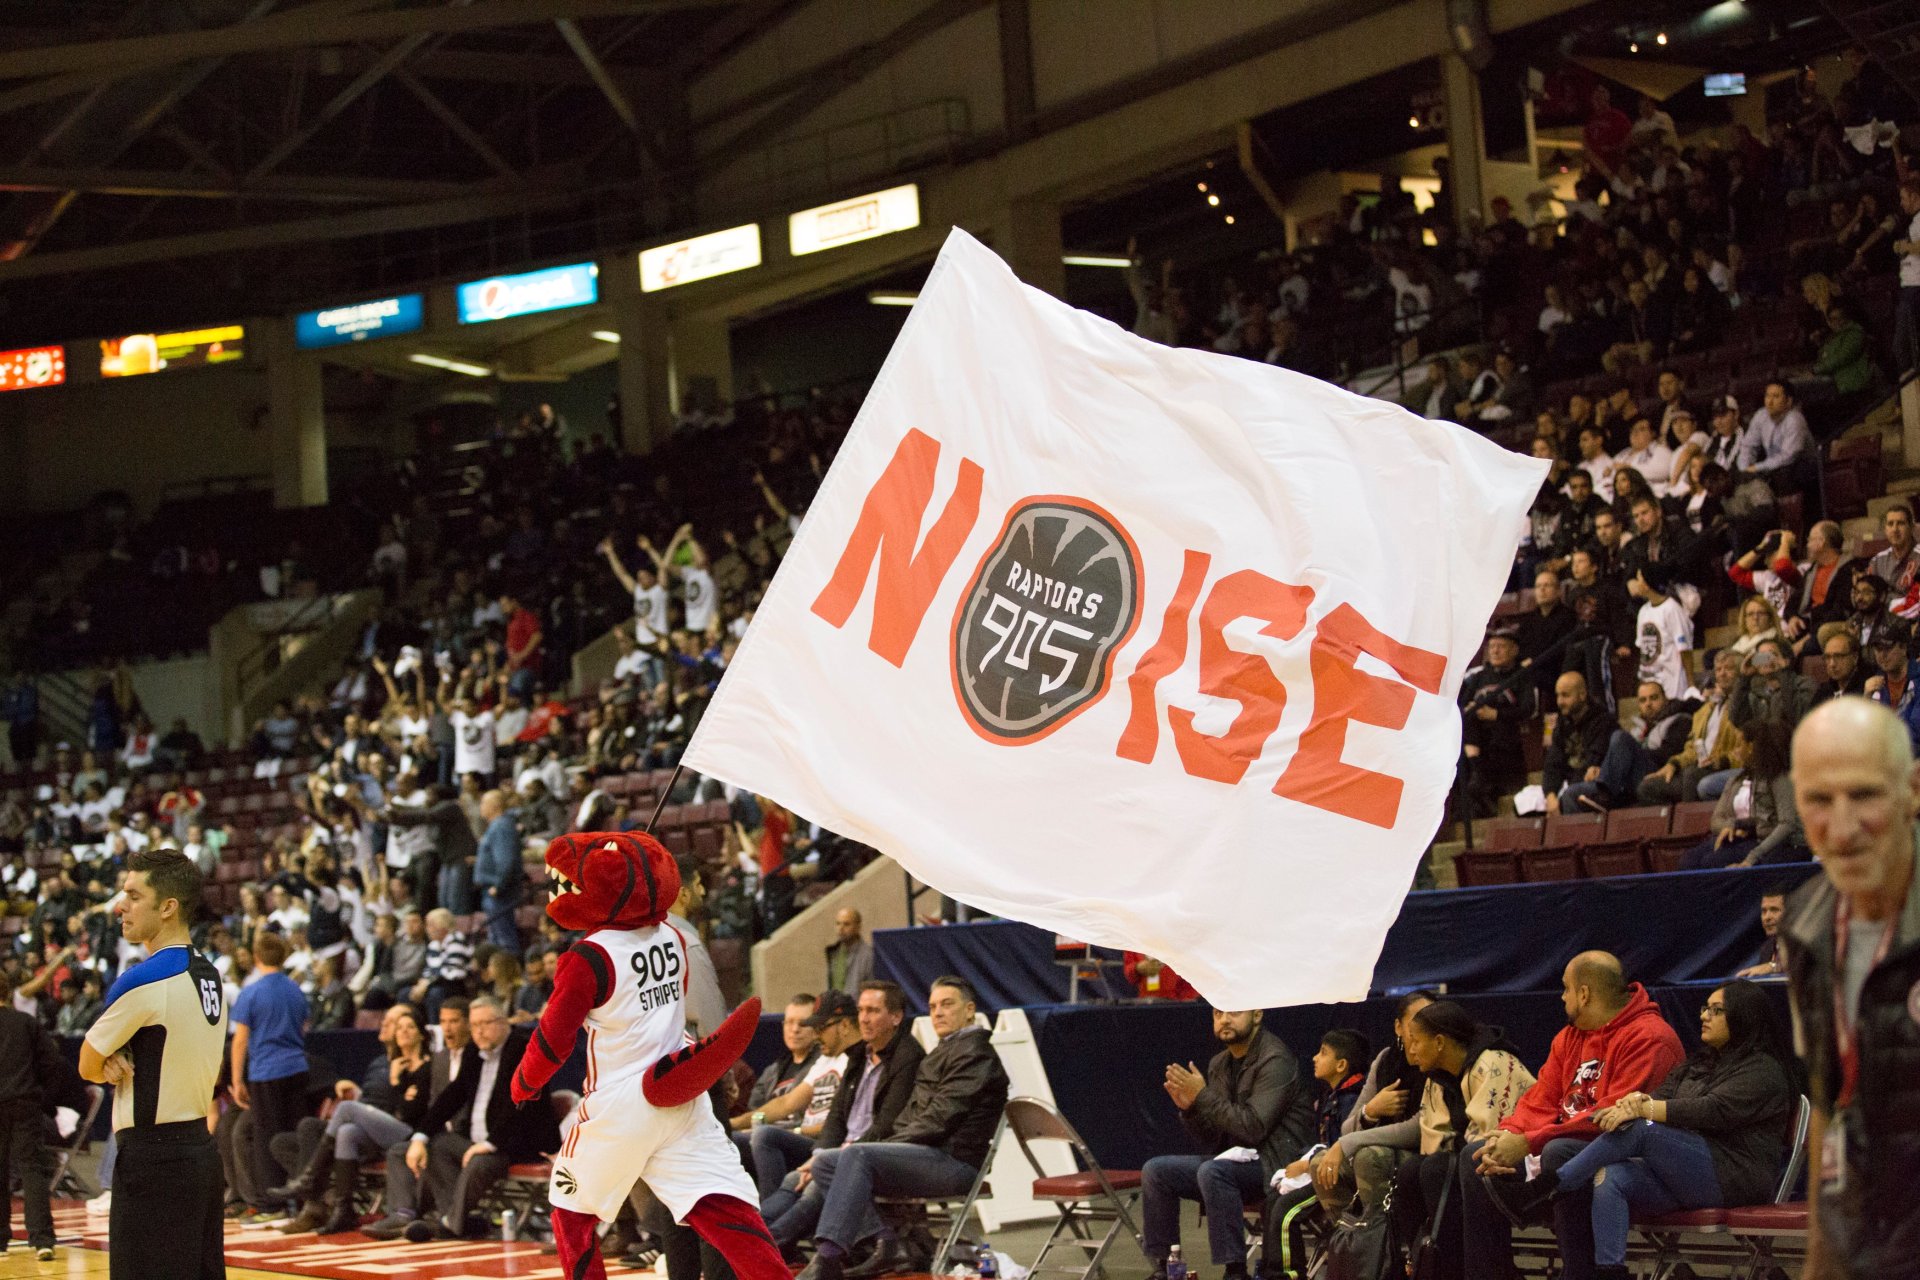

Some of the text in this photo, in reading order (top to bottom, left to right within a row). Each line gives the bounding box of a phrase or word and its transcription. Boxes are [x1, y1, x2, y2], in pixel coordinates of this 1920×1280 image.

[1006, 561, 1103, 620] RAPTORS
[979, 593, 1095, 695] 905
[631, 942, 680, 989] 905
[200, 978, 220, 1017] 65
